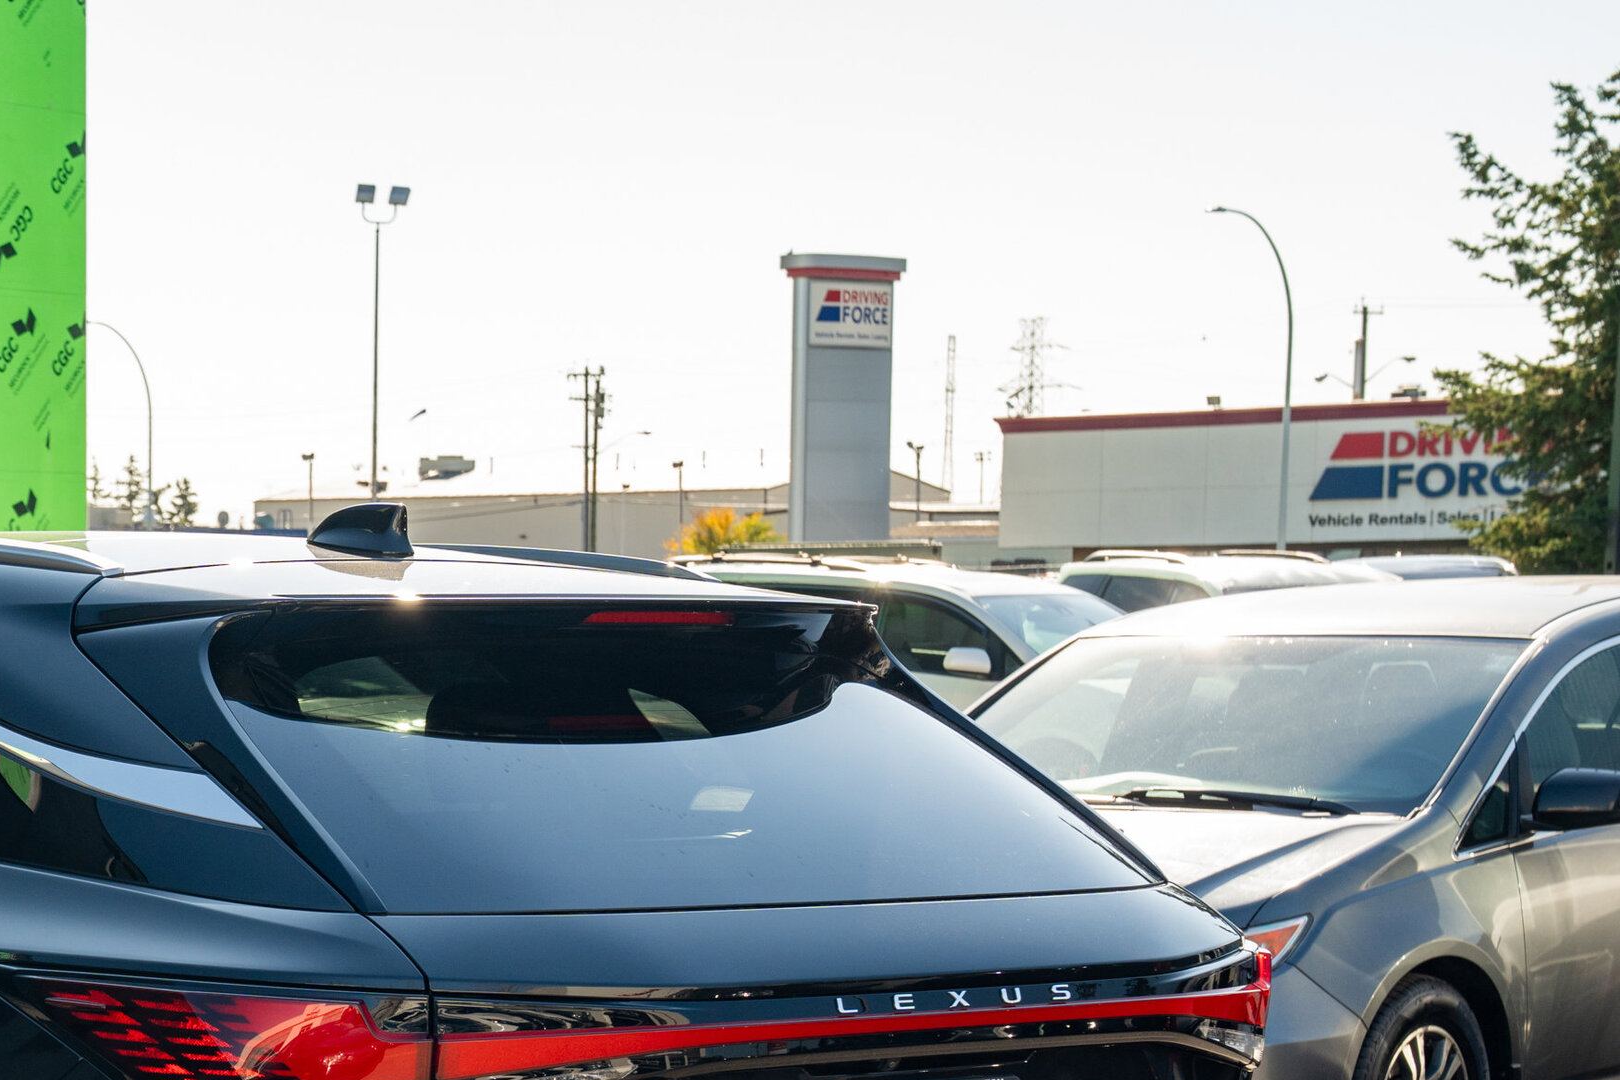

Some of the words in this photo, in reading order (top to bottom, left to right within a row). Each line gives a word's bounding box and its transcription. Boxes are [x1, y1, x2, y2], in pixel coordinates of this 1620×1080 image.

[50, 157, 74, 194] CGC
[9, 205, 34, 242] CGC
[843, 290, 888, 305] DRIVING
[842, 306, 888, 325] FORCE
[52, 340, 75, 376] CGC
[1308, 509, 1364, 528] Vehicle
[1368, 507, 1427, 526] Rentals
[836, 983, 1072, 1014] LEXUS
